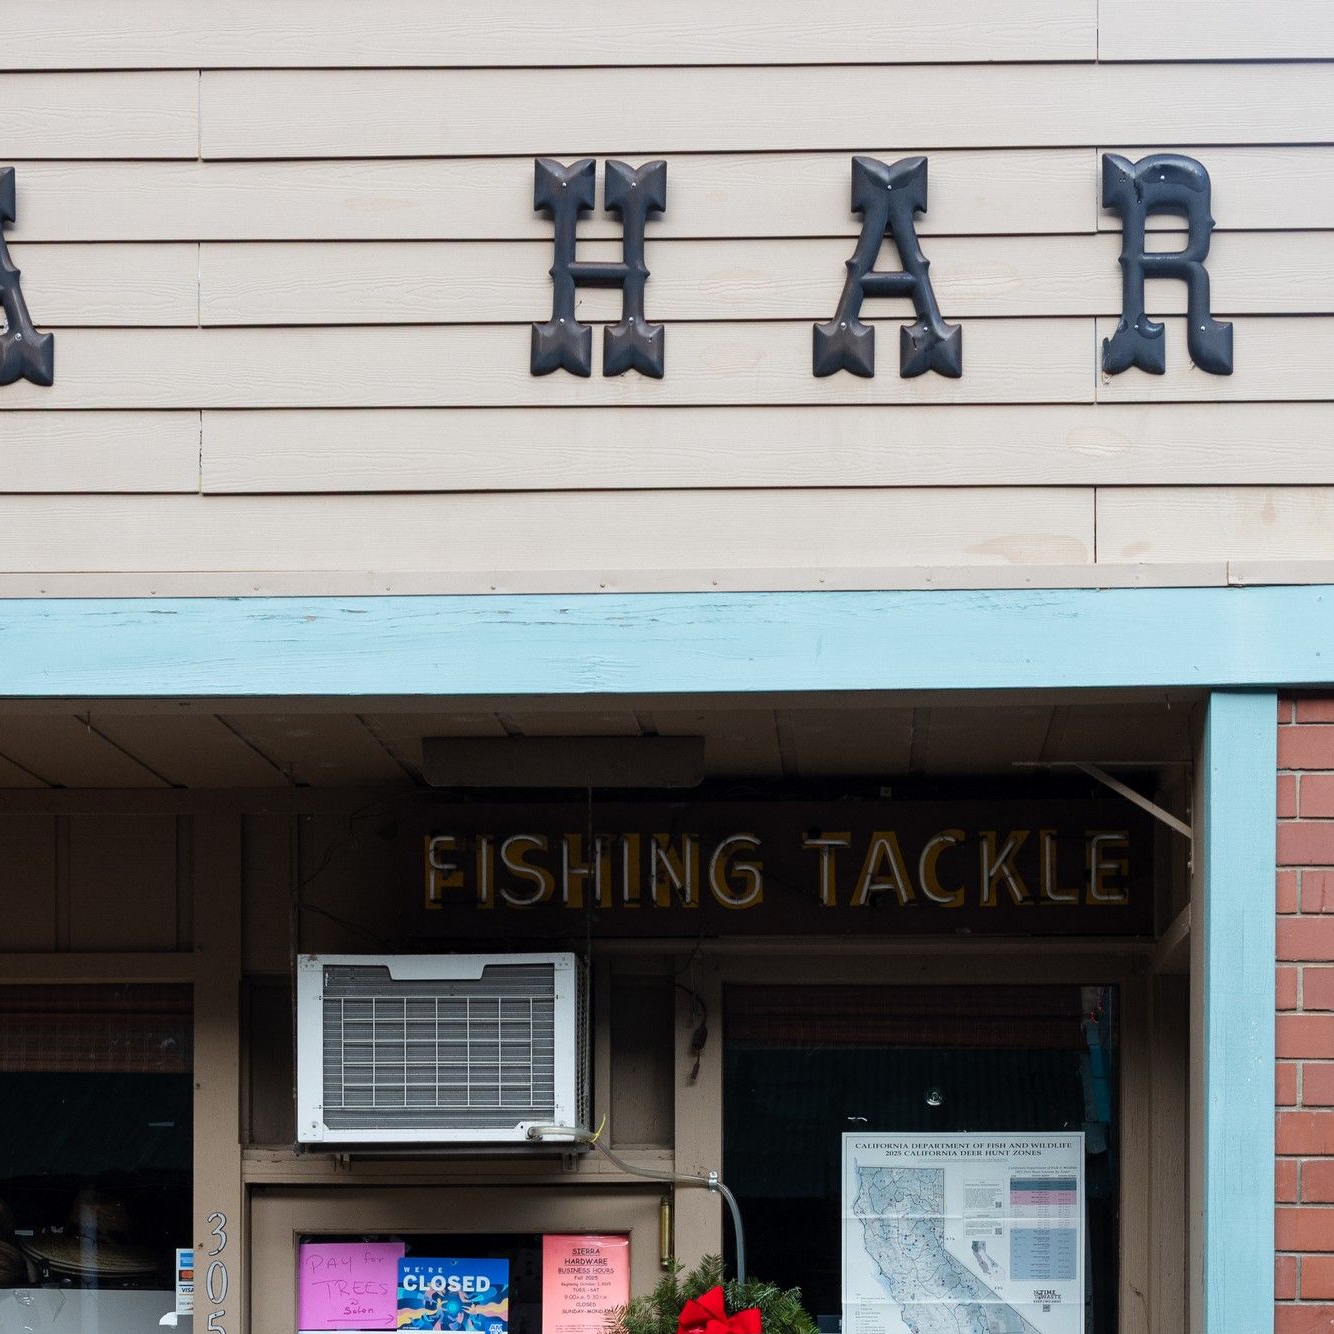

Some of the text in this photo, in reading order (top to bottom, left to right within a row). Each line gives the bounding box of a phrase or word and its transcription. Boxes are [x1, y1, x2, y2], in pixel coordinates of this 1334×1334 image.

[424, 828, 1130, 909] FISHING TACKLE
[306, 1255, 353, 1274] PAY
[312, 1279, 388, 1298] TREES
[403, 1275, 490, 1292] CLOSED
